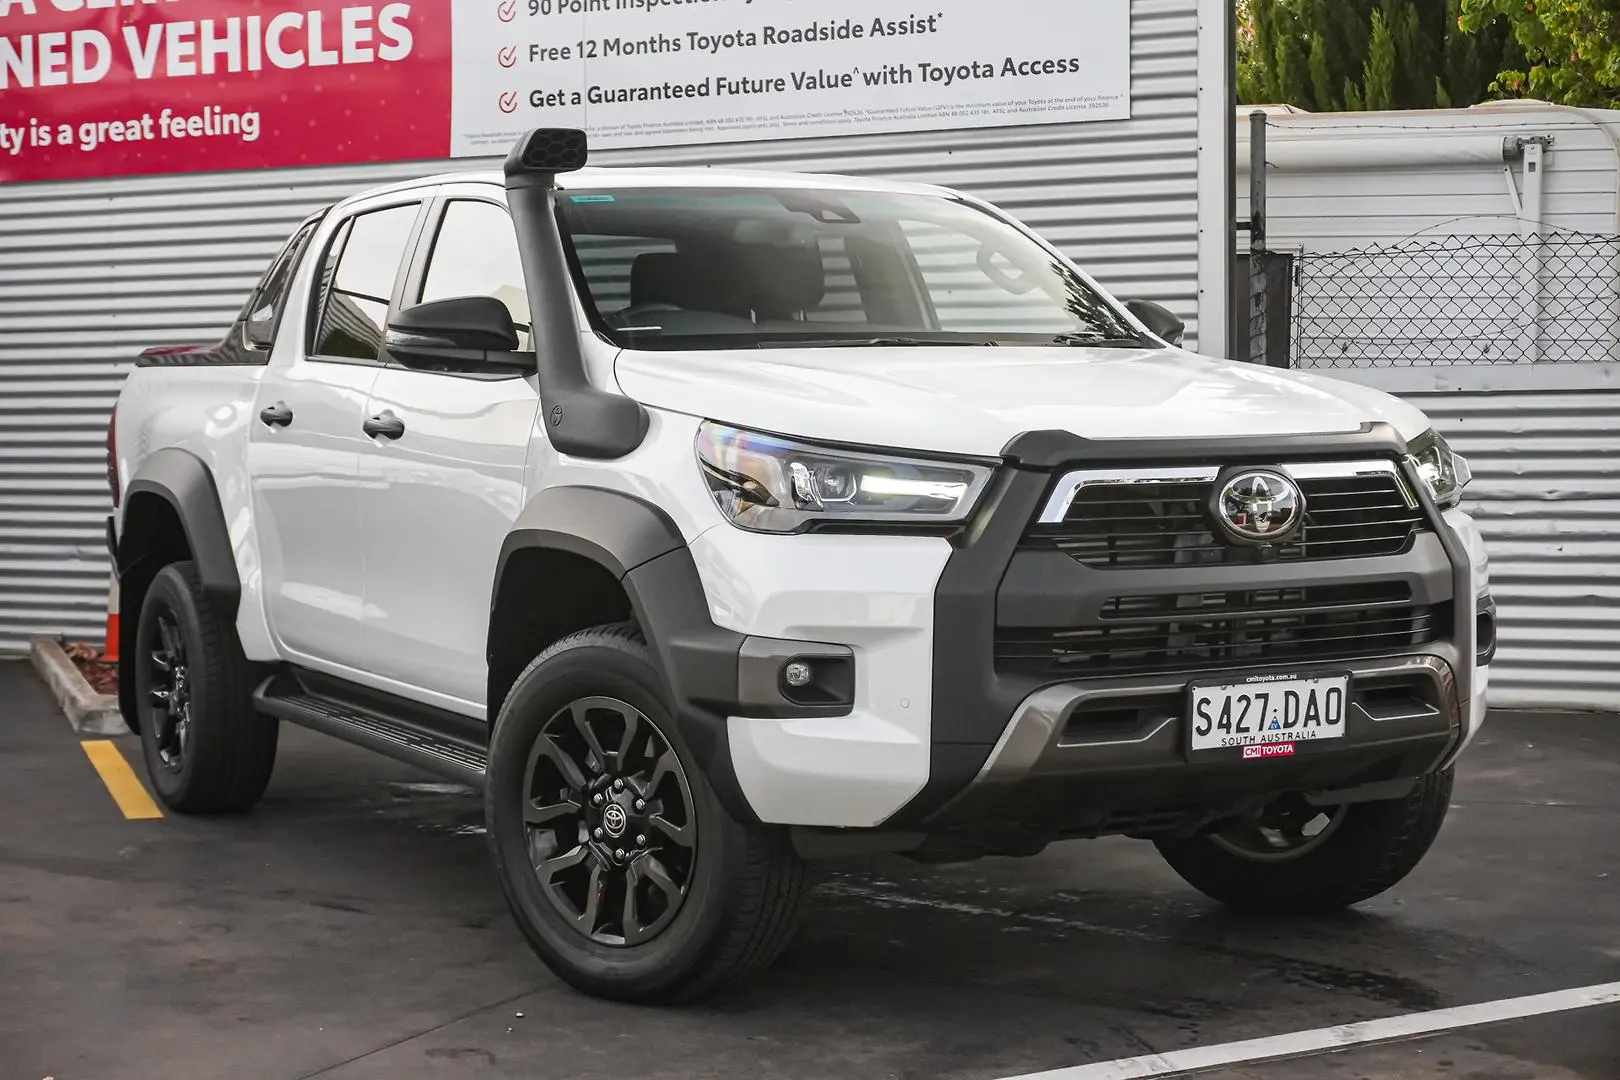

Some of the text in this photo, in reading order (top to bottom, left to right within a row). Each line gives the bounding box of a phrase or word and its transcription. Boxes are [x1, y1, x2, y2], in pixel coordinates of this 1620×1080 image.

[528, 0, 552, 16] 90
[558, 0, 610, 14] Point
[0, 2, 414, 89] NED VEHICLES
[529, 44, 571, 63] Free
[576, 40, 598, 59] 12
[603, 33, 681, 57] Months
[686, 29, 757, 55] Toyota
[763, 18, 864, 45] Roadside
[529, 89, 566, 108] Get
[570, 91, 582, 106] a
[587, 76, 710, 105] Guaranteed
[716, 76, 786, 96] Future
[862, 63, 913, 86] with
[917, 60, 994, 87] Toyota
[1000, 57, 1080, 78] Access
[0, 105, 260, 155] ty is a great feeling
[1246, 674, 1297, 683] cmitoyota.com.au
[1195, 686, 1342, 737] S427 DAO
[1221, 730, 1317, 747] SOUTH AUSTRALIA
[1262, 743, 1294, 755] TOYOTA
